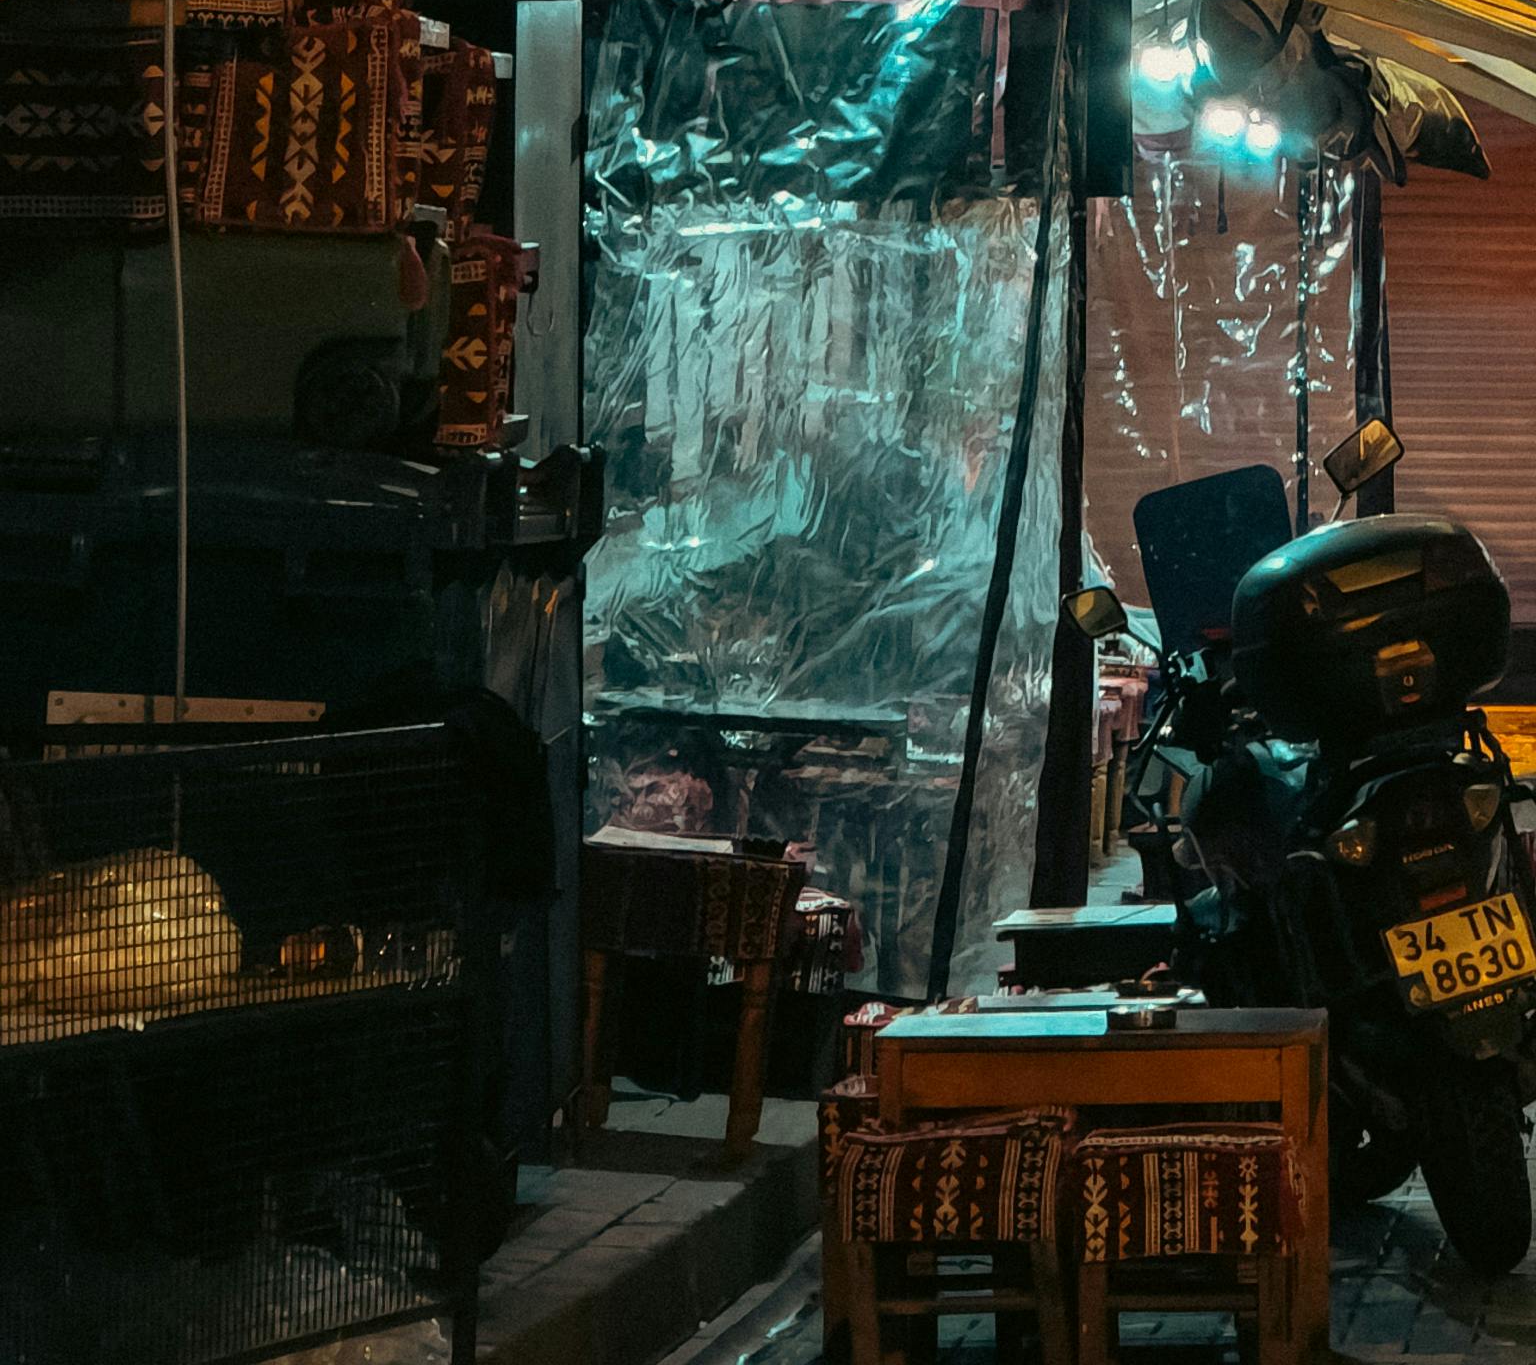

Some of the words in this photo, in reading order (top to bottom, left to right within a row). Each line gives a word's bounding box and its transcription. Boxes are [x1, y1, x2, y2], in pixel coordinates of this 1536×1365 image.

[1396, 921, 1447, 961] 34
[1458, 899, 1516, 941] TN
[1432, 938, 1526, 994] 8630
